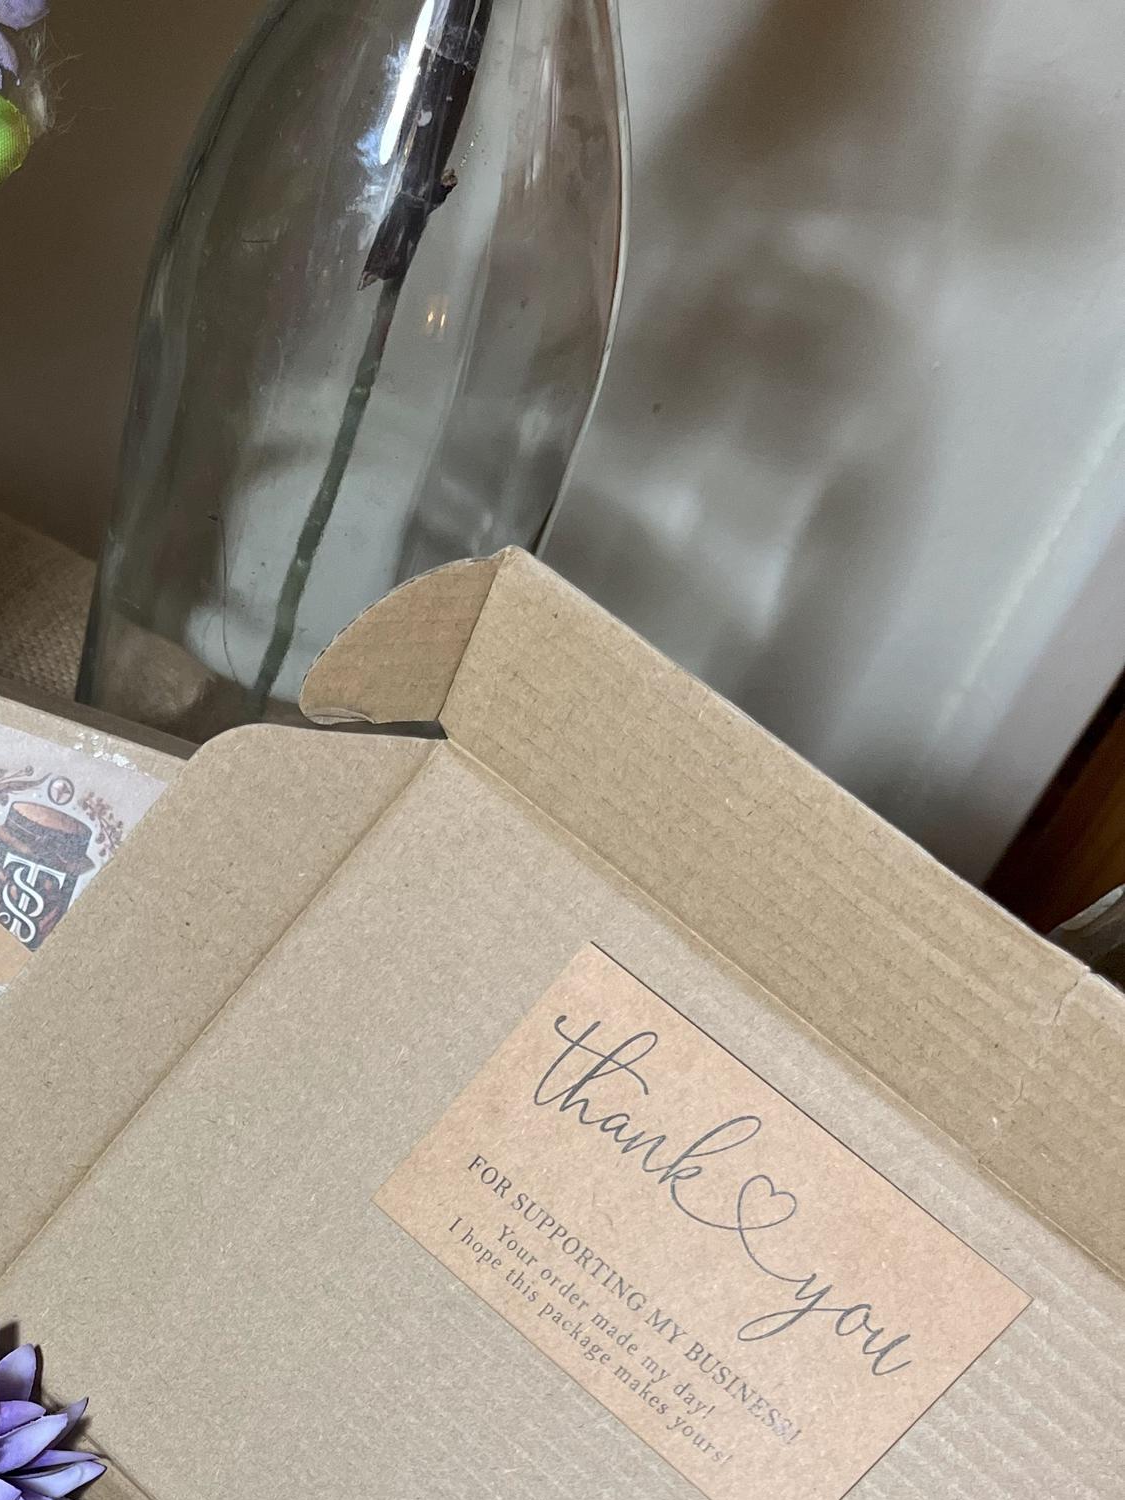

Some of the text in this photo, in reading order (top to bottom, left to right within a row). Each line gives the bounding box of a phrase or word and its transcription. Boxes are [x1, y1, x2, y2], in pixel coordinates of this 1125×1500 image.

[468, 1155, 800, 1443] FOR SUPPORTING MY BUSINESS!
[498, 1224, 715, 1418] Your order made my day!
[535, 1017, 910, 1375] thank you
[449, 1217, 732, 1463] I hope this package makes yours!
